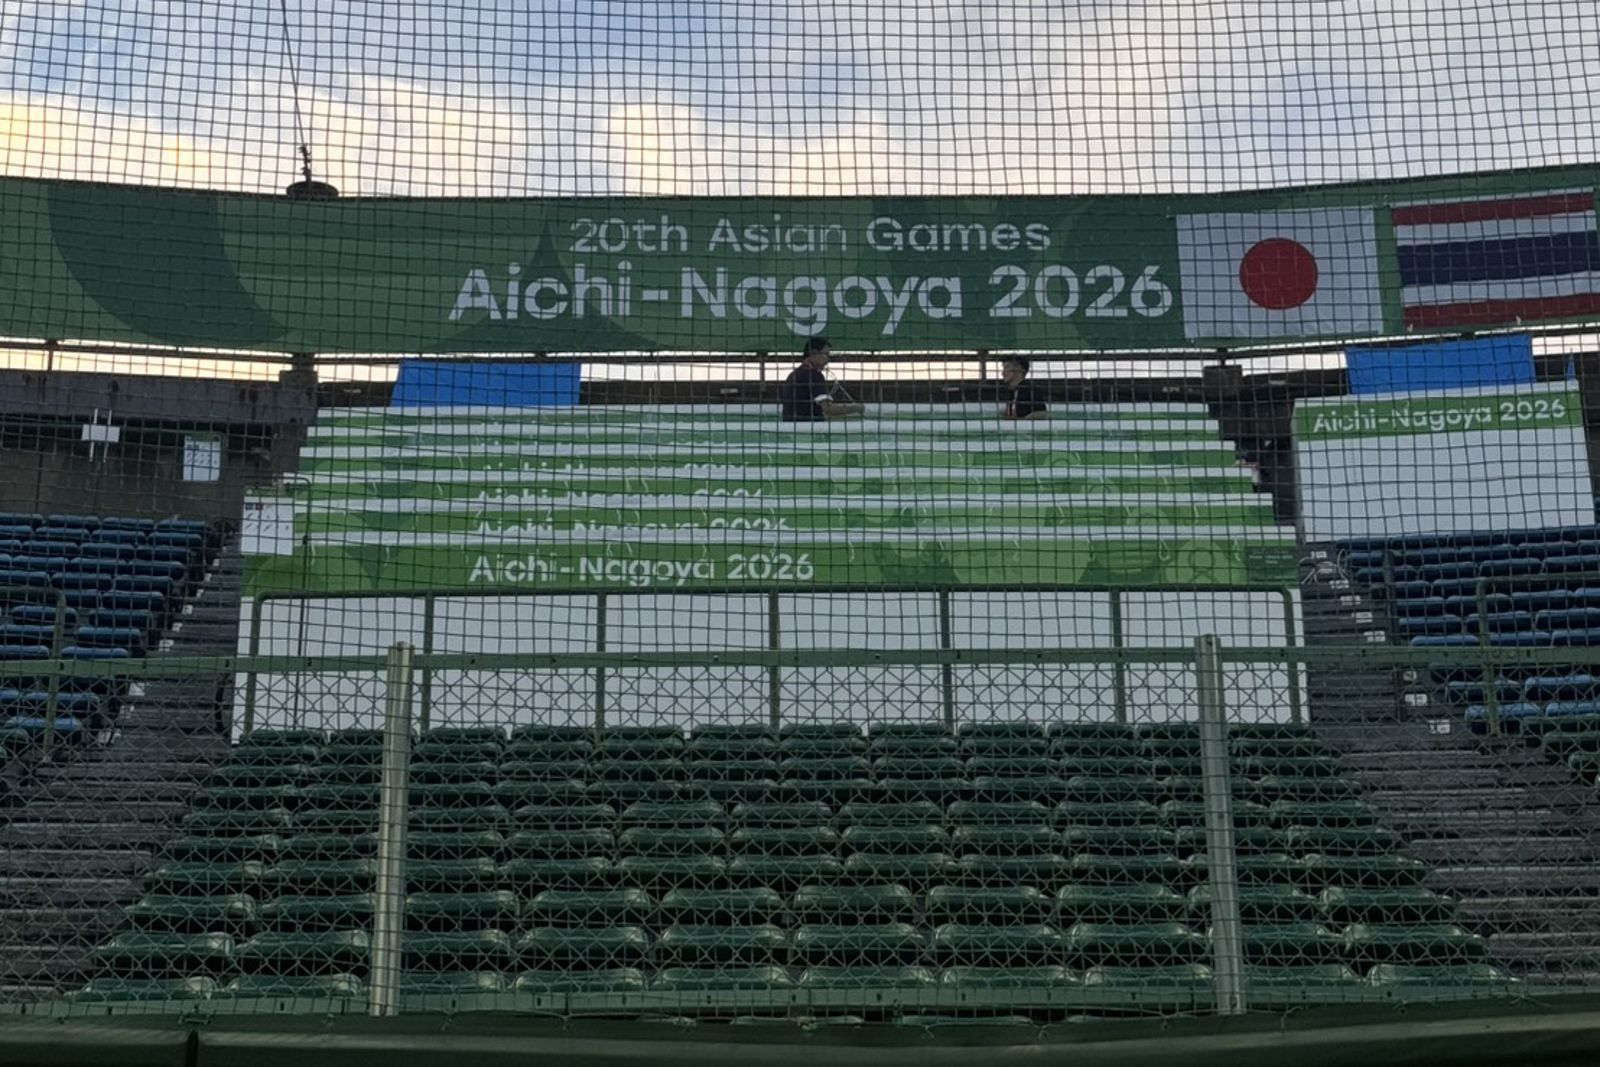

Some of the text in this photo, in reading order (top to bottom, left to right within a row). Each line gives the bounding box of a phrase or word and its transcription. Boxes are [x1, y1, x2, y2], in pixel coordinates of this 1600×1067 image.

[569, 213, 1051, 253] 20th Asian Games
[448, 261, 1174, 337] Aichi-Nagoya 2026
[1313, 398, 1567, 433] Aichi-Nagoya 2026
[468, 553, 815, 587] Aichi-Nagoya 2026
